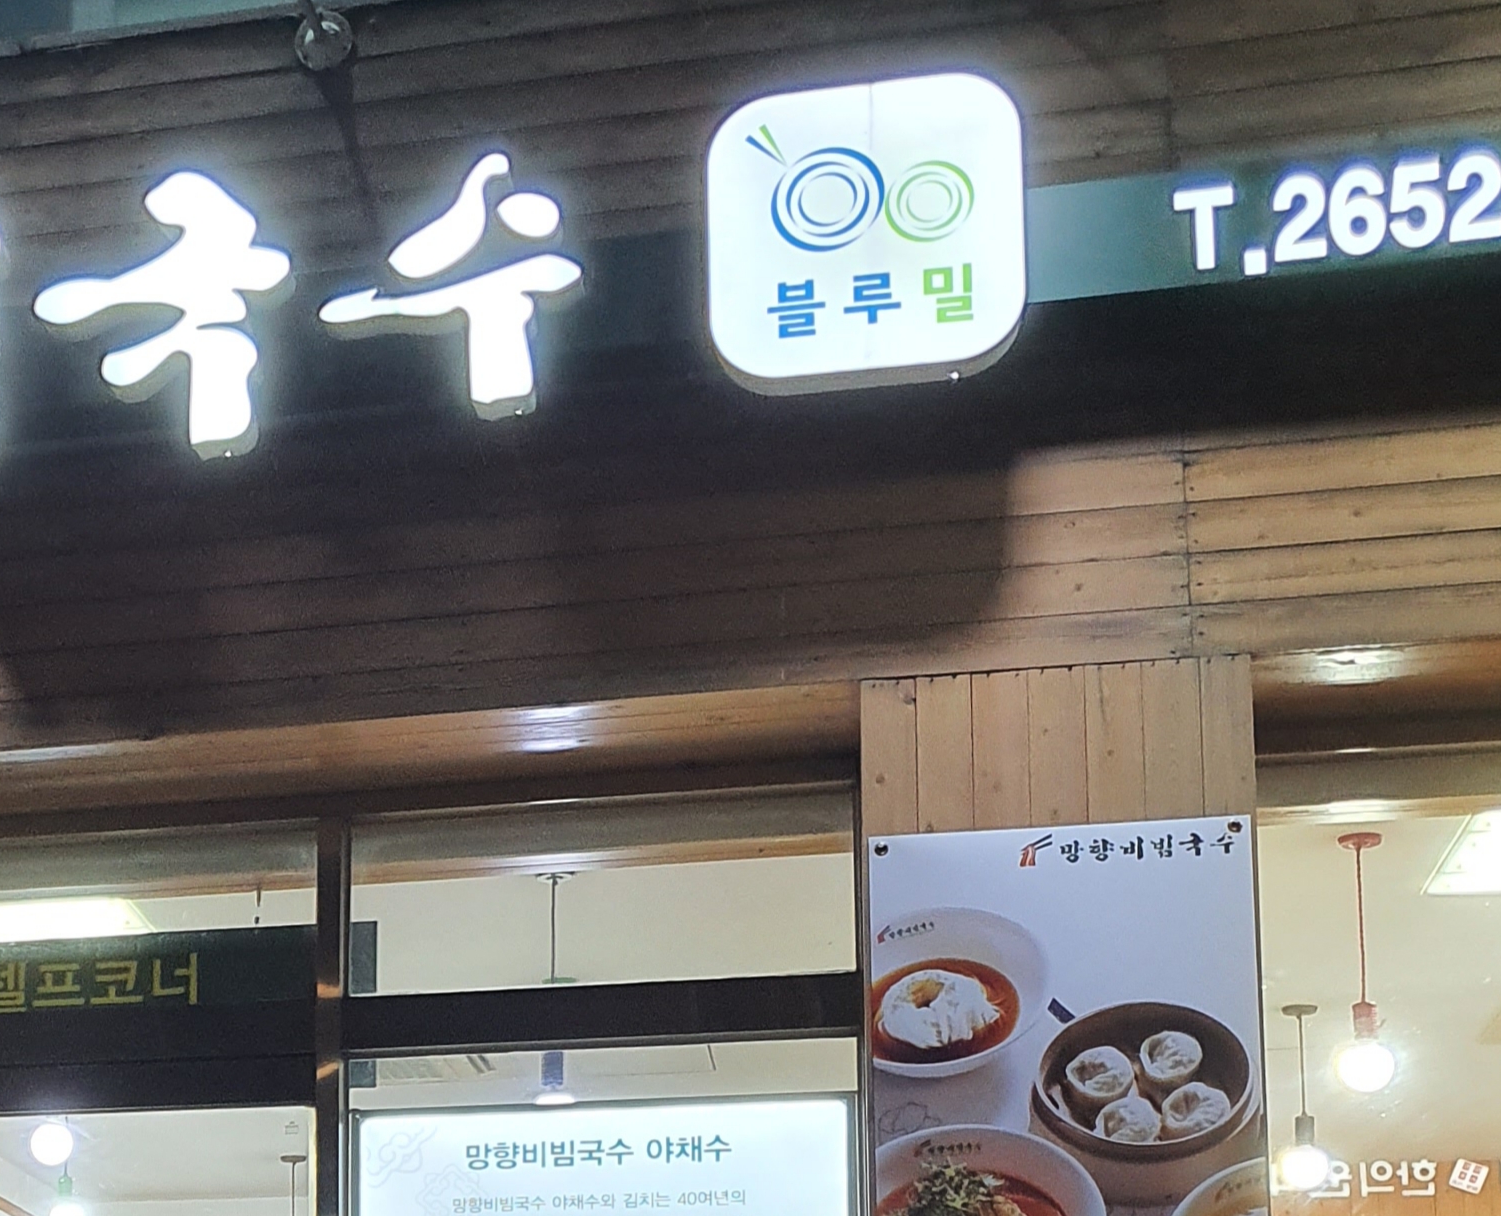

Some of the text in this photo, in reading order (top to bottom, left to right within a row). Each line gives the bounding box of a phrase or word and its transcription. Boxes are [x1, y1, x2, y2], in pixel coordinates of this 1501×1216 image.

[767, 262, 976, 339] 블루밀
[1060, 832, 1236, 863] 망향비빔국수
[465, 1134, 733, 1170] 망향비빔국수 야채수
[452, 1189, 746, 1214] 망향비빔국수 야채수와 김치는 40여년의
